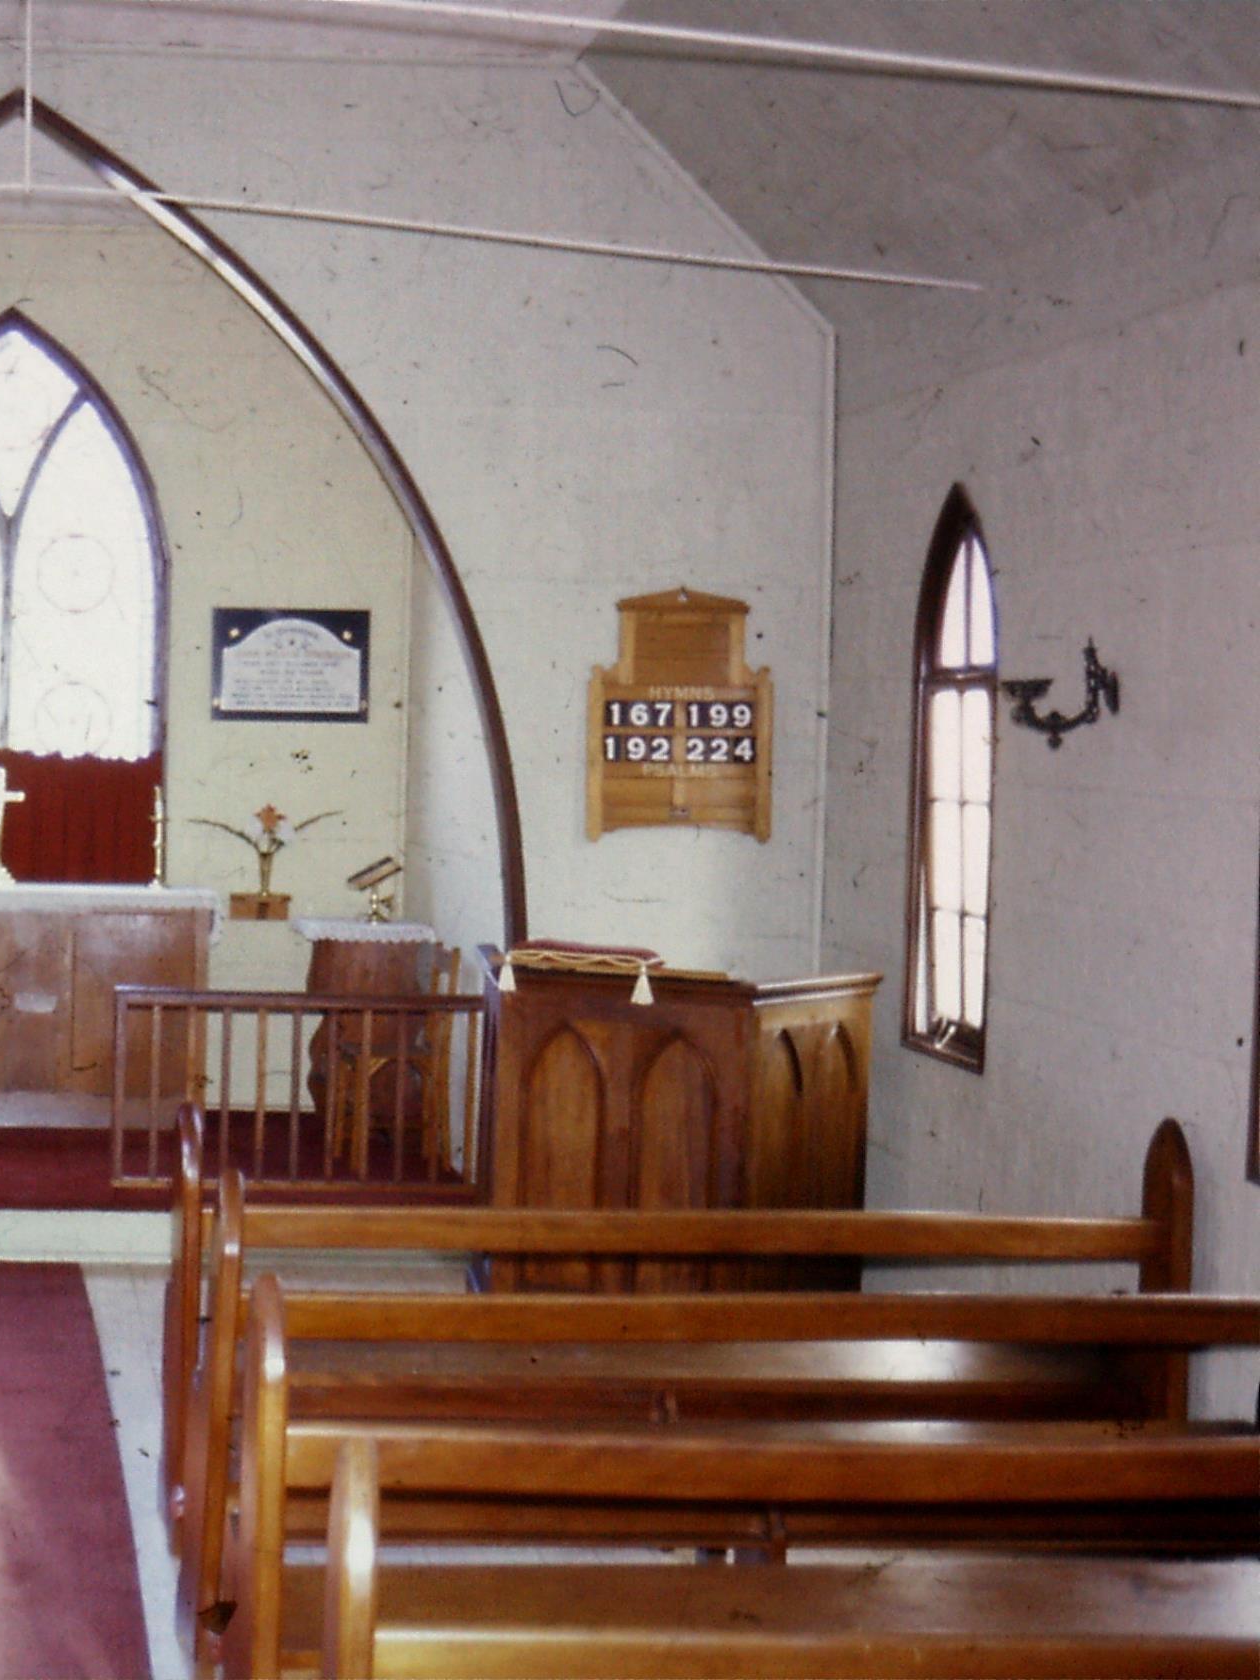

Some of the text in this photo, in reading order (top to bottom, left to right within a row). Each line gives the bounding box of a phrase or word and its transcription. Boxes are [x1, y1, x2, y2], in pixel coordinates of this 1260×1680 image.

[649, 686, 715, 700] HYMNS
[609, 702, 752, 728] 167 199
[605, 737, 754, 761] 192 224
[643, 763, 720, 777] PSALMS
